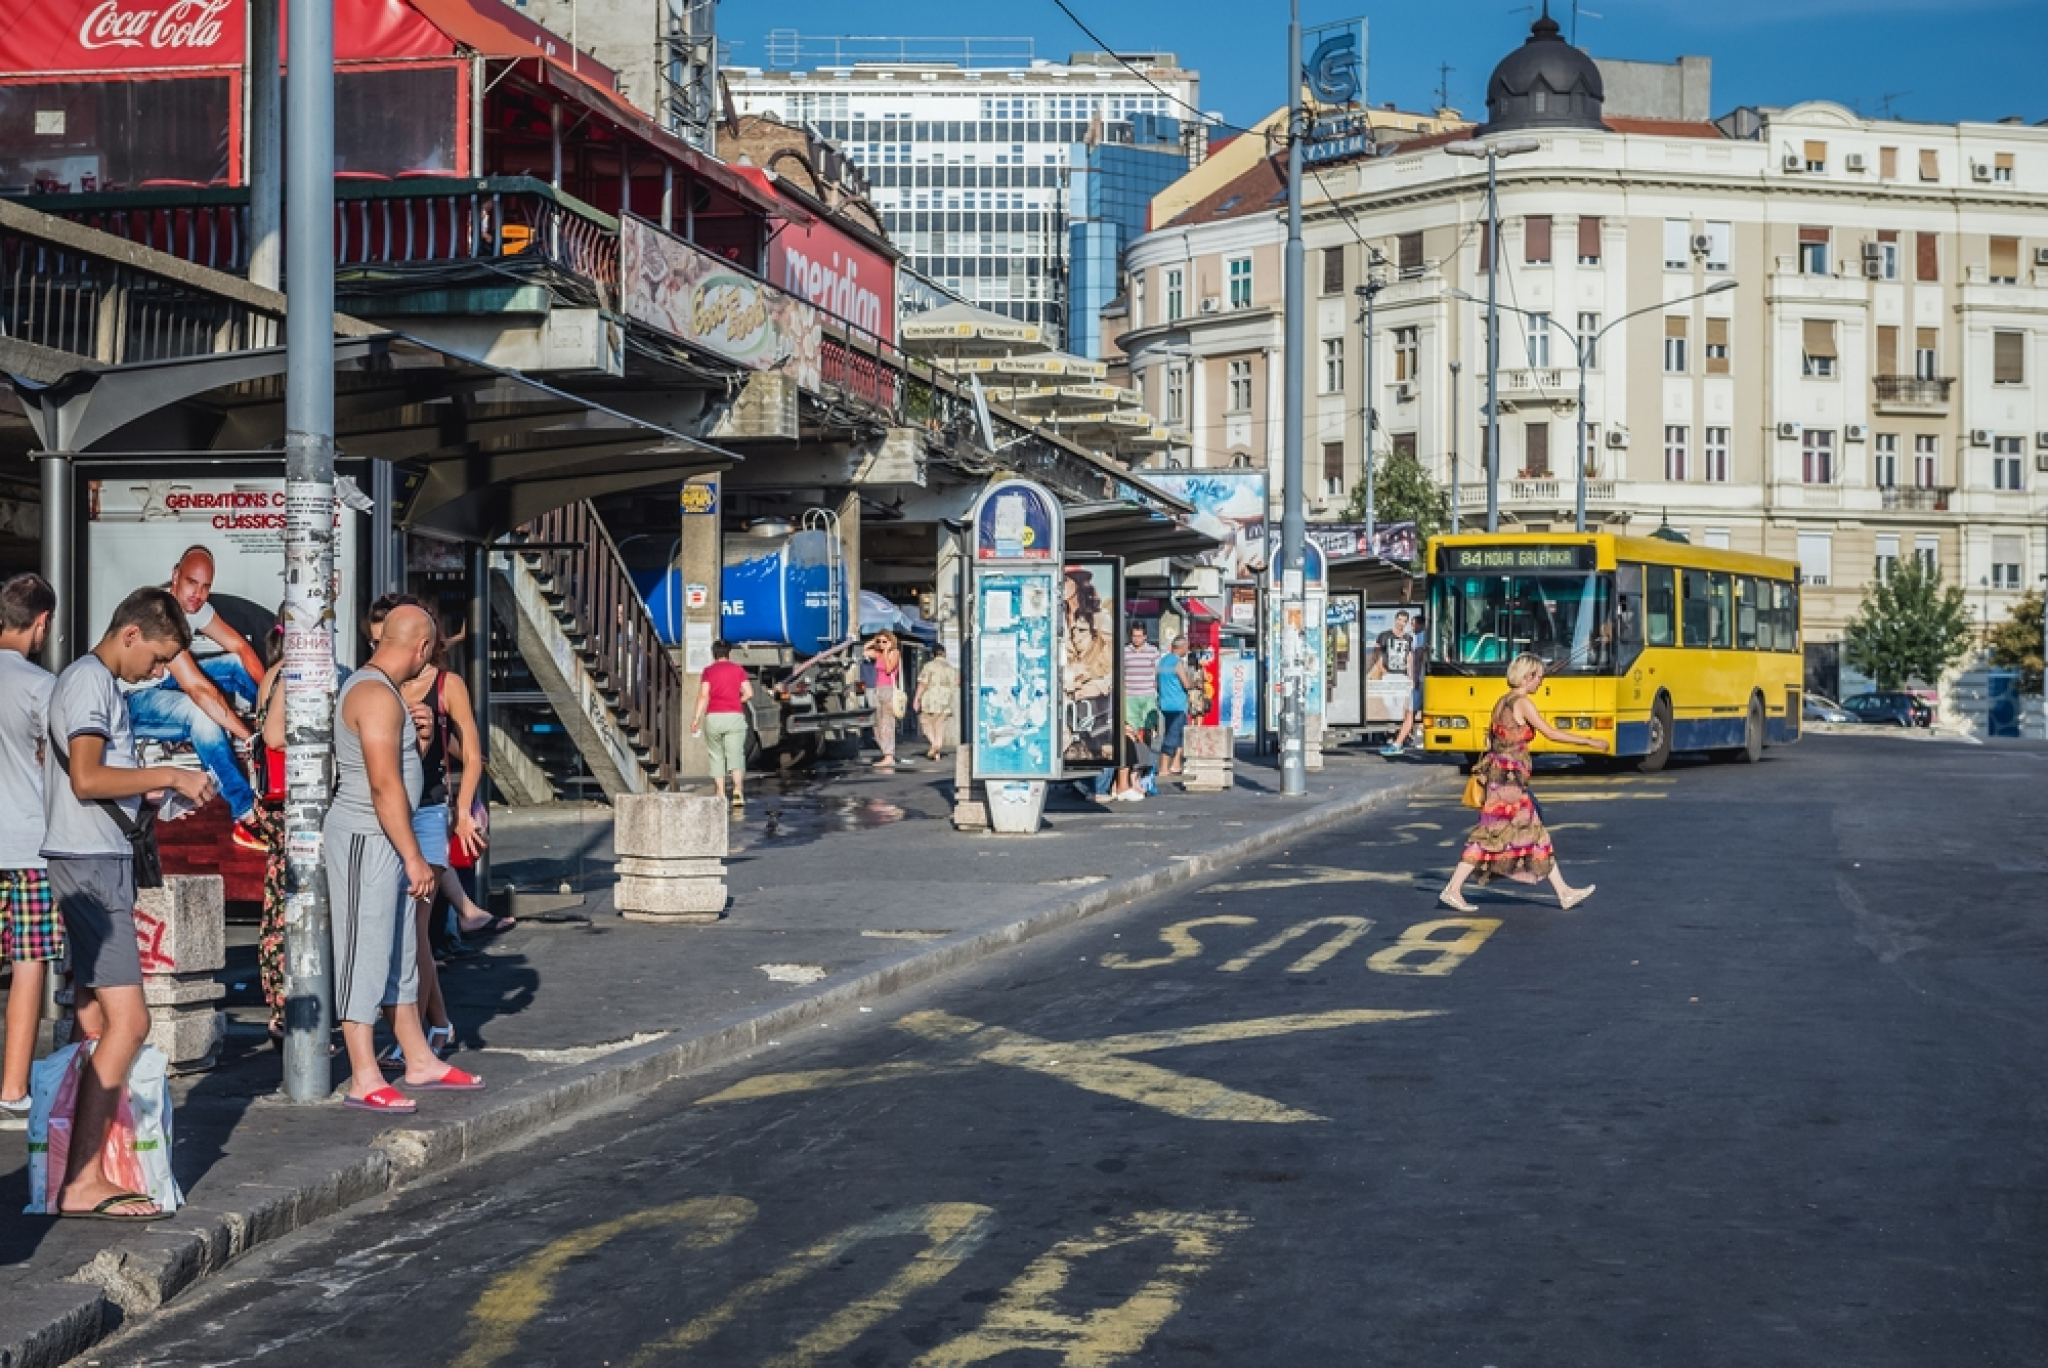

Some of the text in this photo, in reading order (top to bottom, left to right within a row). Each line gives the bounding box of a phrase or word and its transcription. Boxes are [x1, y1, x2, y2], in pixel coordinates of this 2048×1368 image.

[79, 0, 232, 49] Coca-Cola
[785, 247, 881, 345] meridian
[165, 491, 268, 508] GENERATIONS
[212, 514, 287, 529] CLASSICS
[1460, 550, 1572, 566] 84 NOVA GALENIKA
[1100, 914, 1503, 976] BUS
